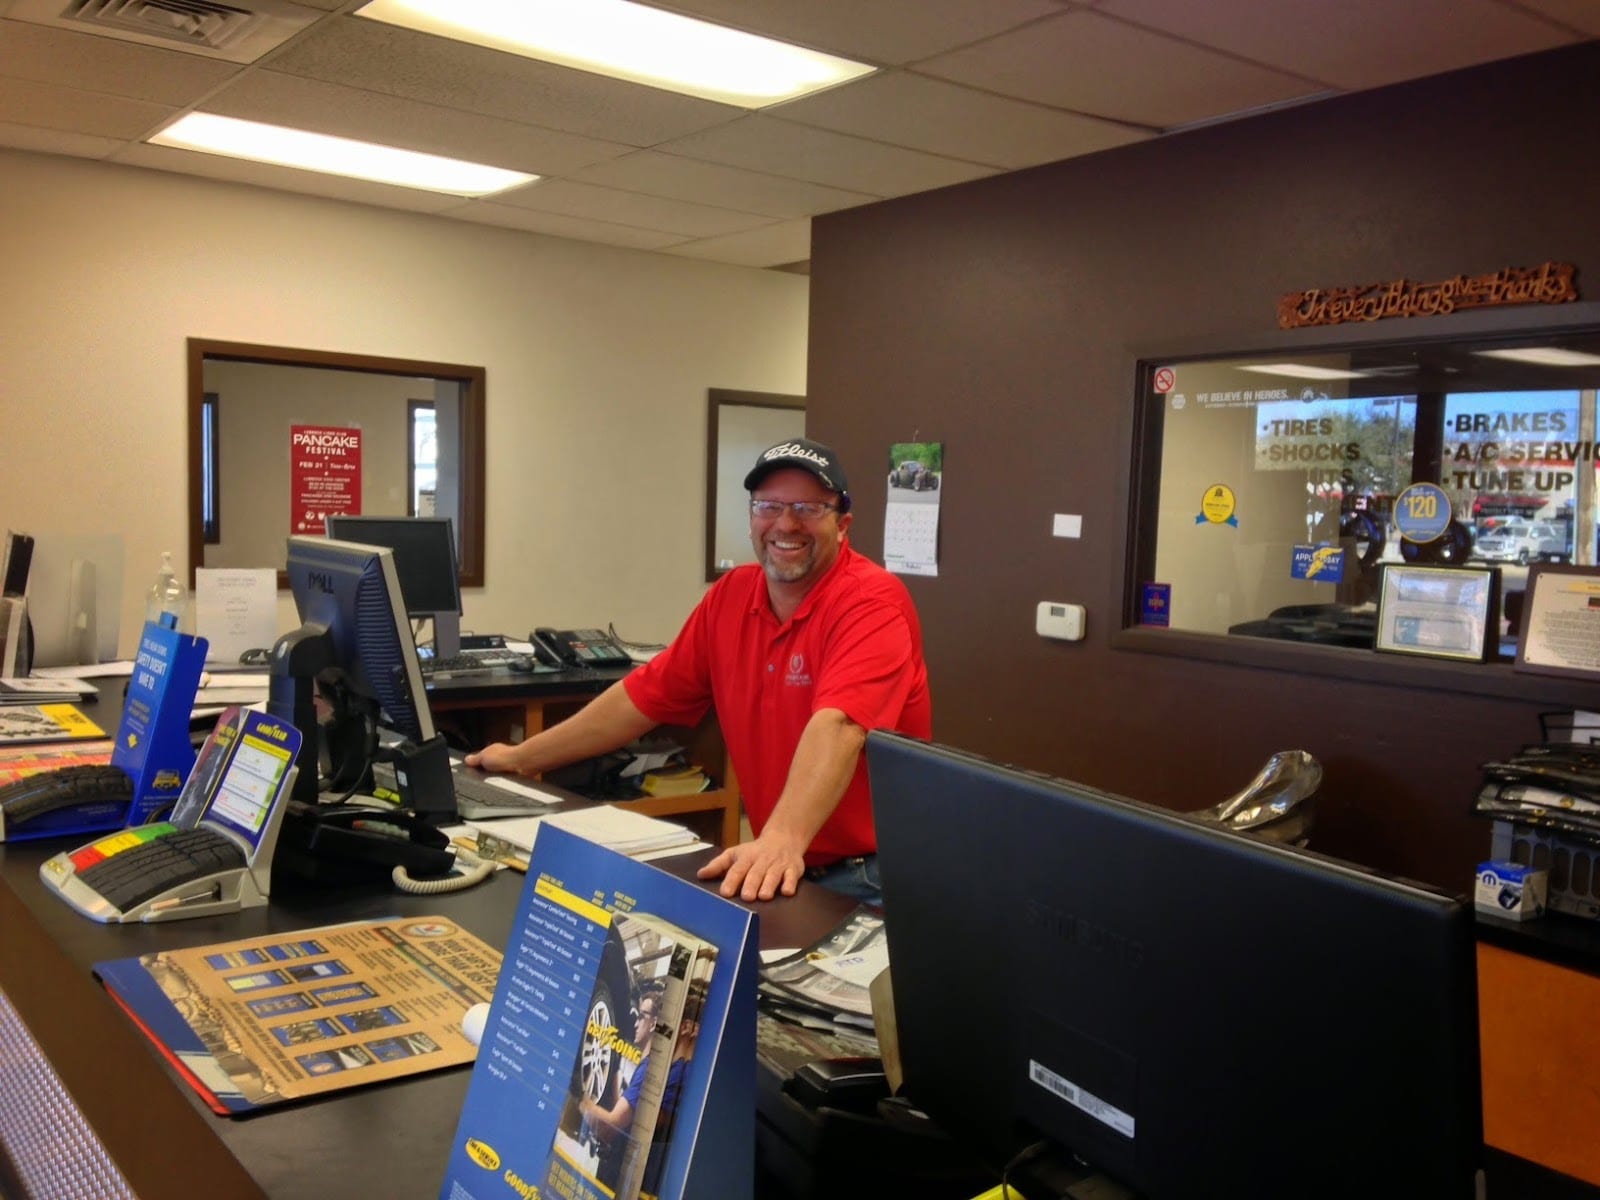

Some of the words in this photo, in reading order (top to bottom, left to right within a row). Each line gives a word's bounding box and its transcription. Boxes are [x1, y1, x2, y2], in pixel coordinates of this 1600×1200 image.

[1490, 262, 1567, 300] thanks
[1196, 393, 1208, 403] WE
[1210, 391, 1241, 402] BELIEVE
[1243, 390, 1252, 401] IN
[1271, 418, 1333, 436] TIRES
[1455, 411, 1567, 432] BRAKES
[293, 433, 359, 448] PANCAKE
[305, 446, 347, 456] FESTIVAL
[1268, 442, 1360, 461] SHOCKS
[1454, 441, 1499, 463] A/C
[1453, 470, 1524, 491] TUNE
[1534, 471, 1573, 491] UP
[609, 1034, 642, 1066] GOING
